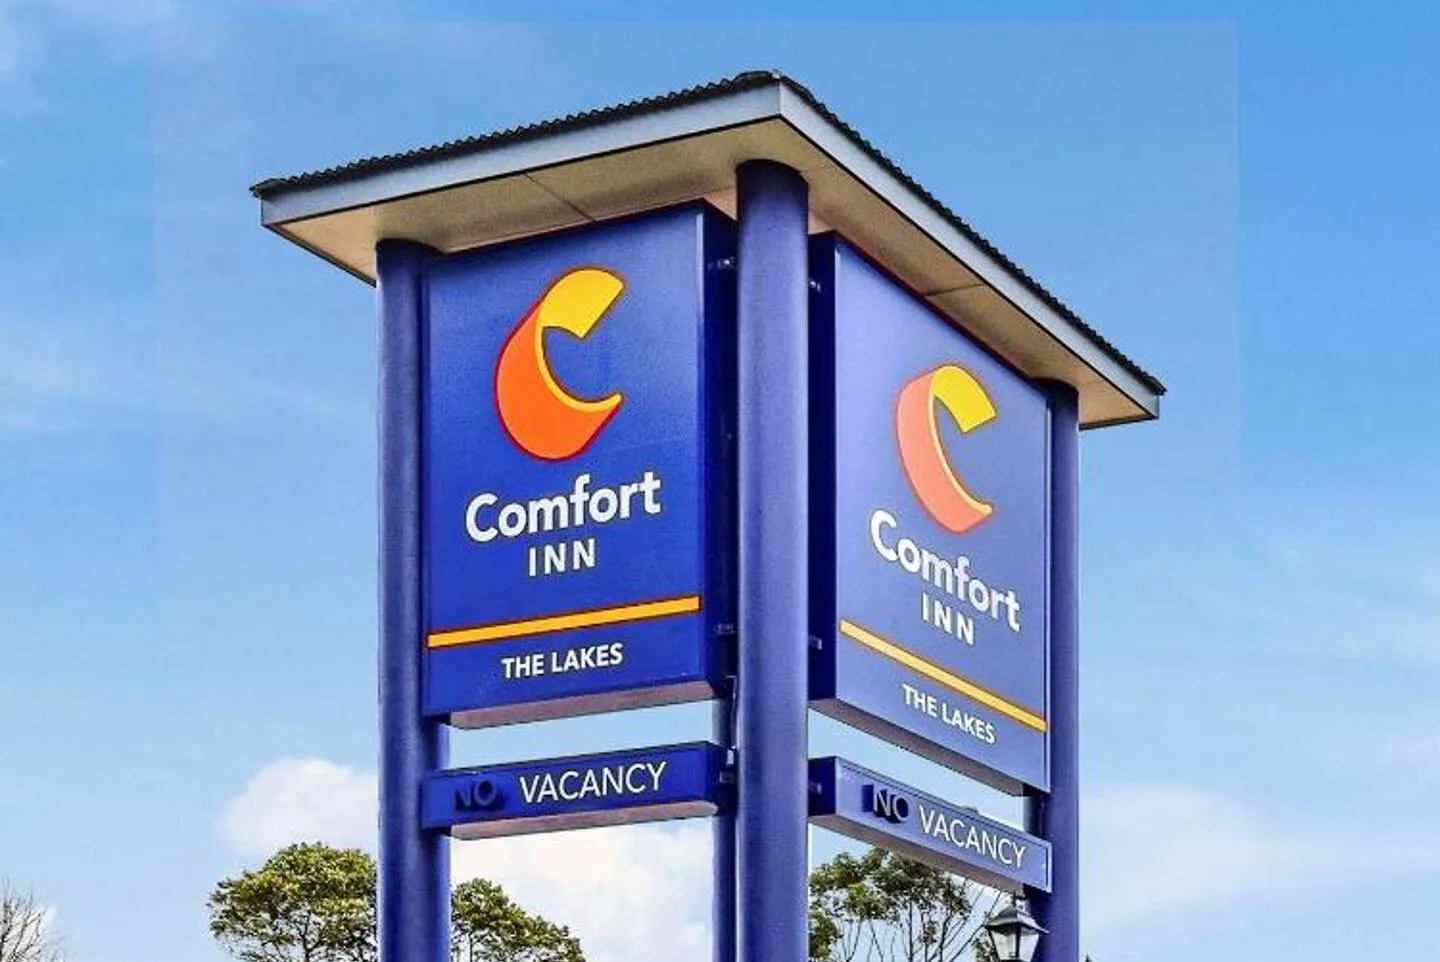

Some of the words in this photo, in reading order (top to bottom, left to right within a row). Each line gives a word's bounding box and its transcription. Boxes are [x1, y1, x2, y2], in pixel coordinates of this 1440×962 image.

[466, 471, 661, 542] Comfort
[528, 538, 596, 576] INN
[870, 509, 1020, 632] Comfort
[921, 593, 975, 646] INN
[501, 653, 545, 679] THE
[551, 643, 624, 673] LAKES
[902, 683, 938, 718] THE
[942, 703, 996, 744] LAKES
[455, 780, 499, 809] NO
[519, 761, 667, 803] VACANCY
[872, 788, 911, 823] NO
[919, 804, 1026, 869] VACANCY
